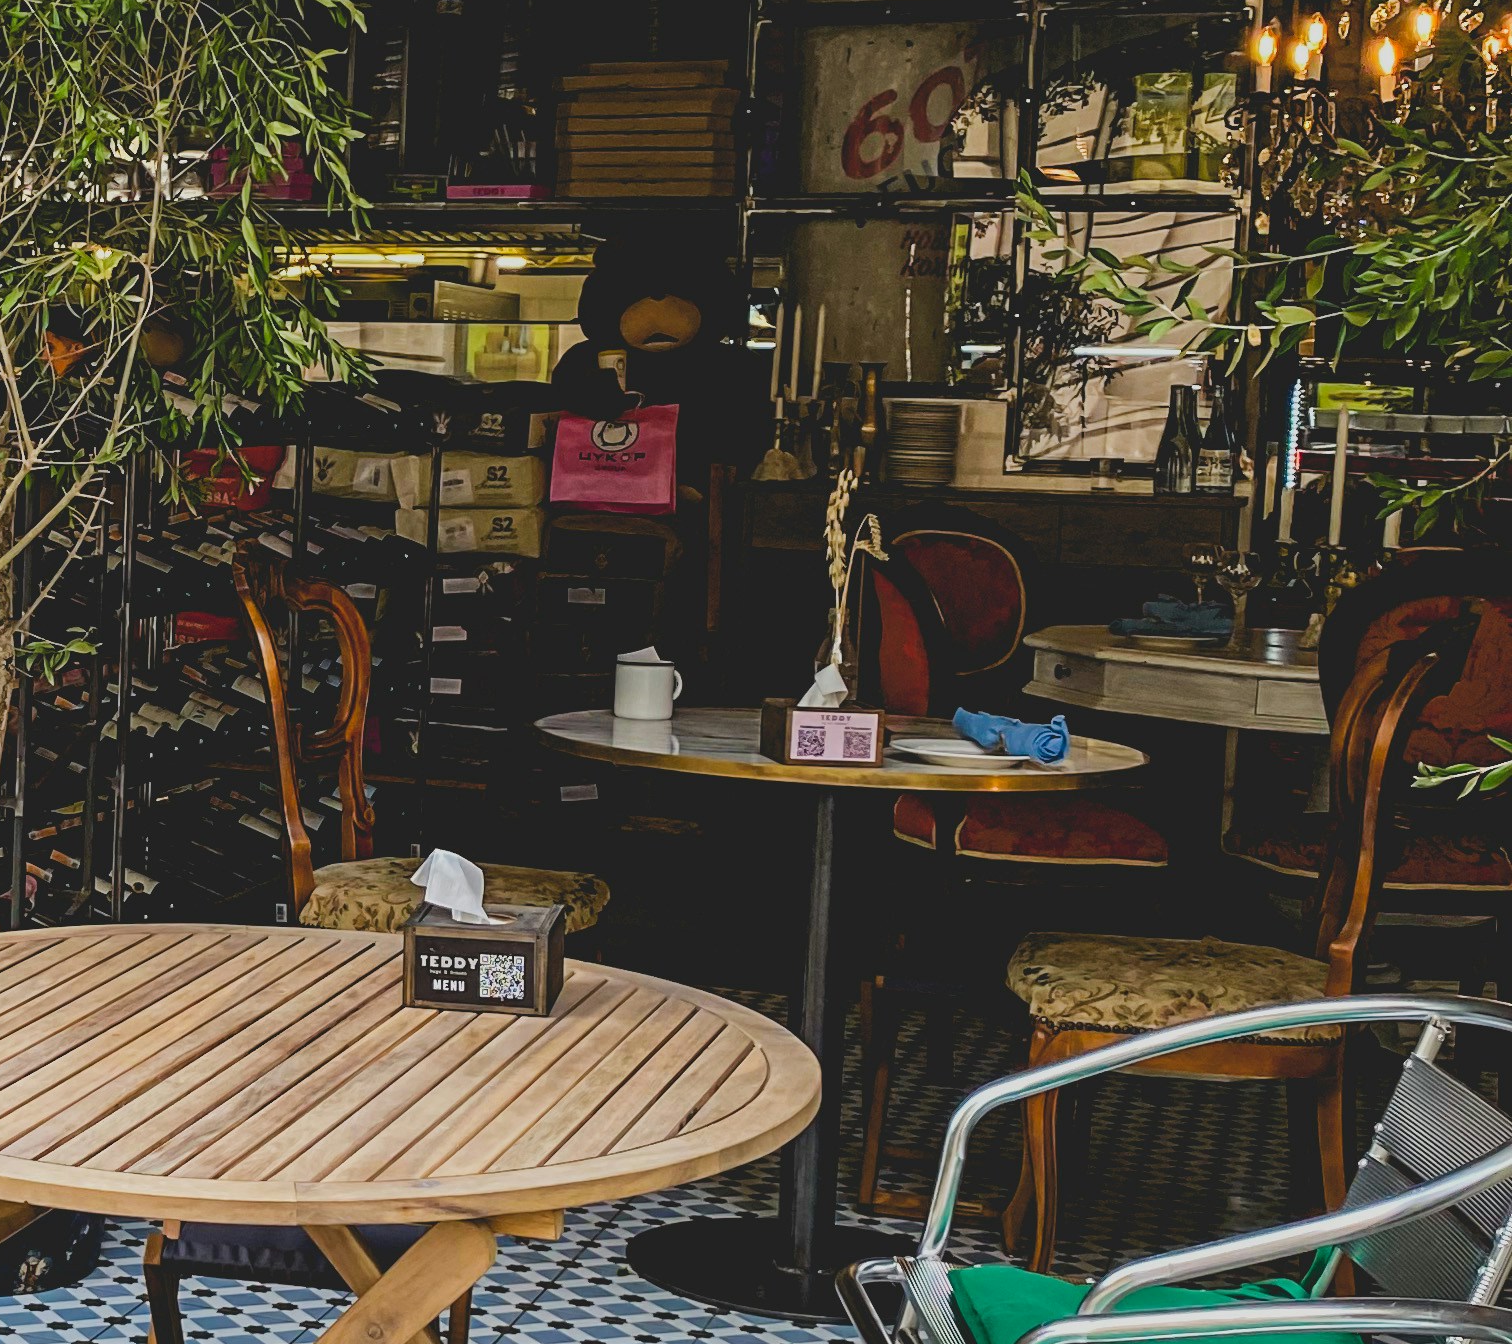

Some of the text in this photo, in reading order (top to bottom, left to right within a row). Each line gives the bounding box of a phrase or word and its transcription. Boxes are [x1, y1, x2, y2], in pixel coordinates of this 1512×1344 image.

[481, 412, 504, 430] S2
[486, 465, 508, 482] S2
[492, 516, 514, 533] S2
[420, 954, 479, 970] TEDDY
[432, 978, 465, 992] MENU
